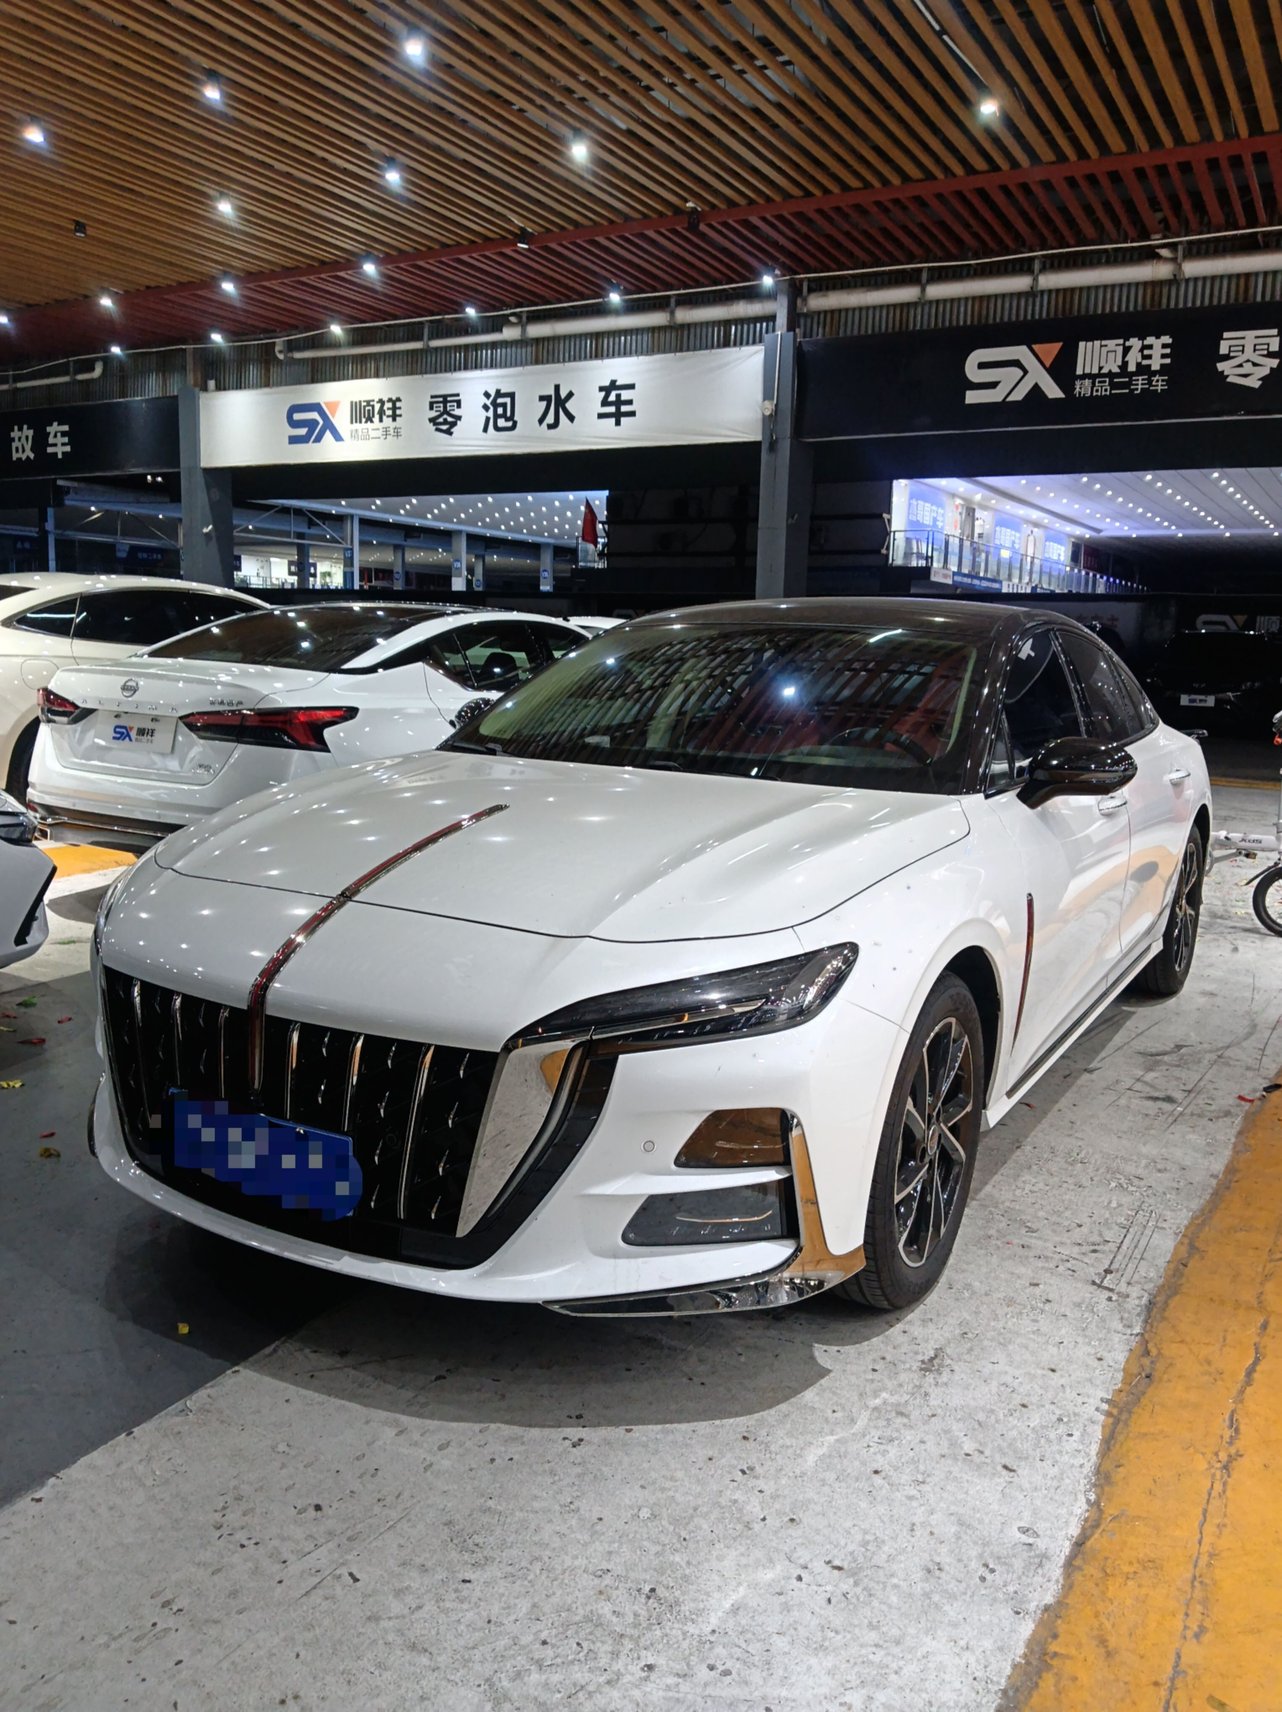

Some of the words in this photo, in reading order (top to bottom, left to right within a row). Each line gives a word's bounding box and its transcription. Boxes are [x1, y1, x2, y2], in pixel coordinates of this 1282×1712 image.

[1075, 335, 1172, 375] 顺祥
[1216, 328, 1280, 389] 零
[1074, 374, 1168, 397] 精品二手车
[350, 397, 402, 424] 顺祥
[428, 380, 637, 436] 零泡水车
[10, 421, 71, 461] 故车
[350, 426, 402, 441] 精品二手车
